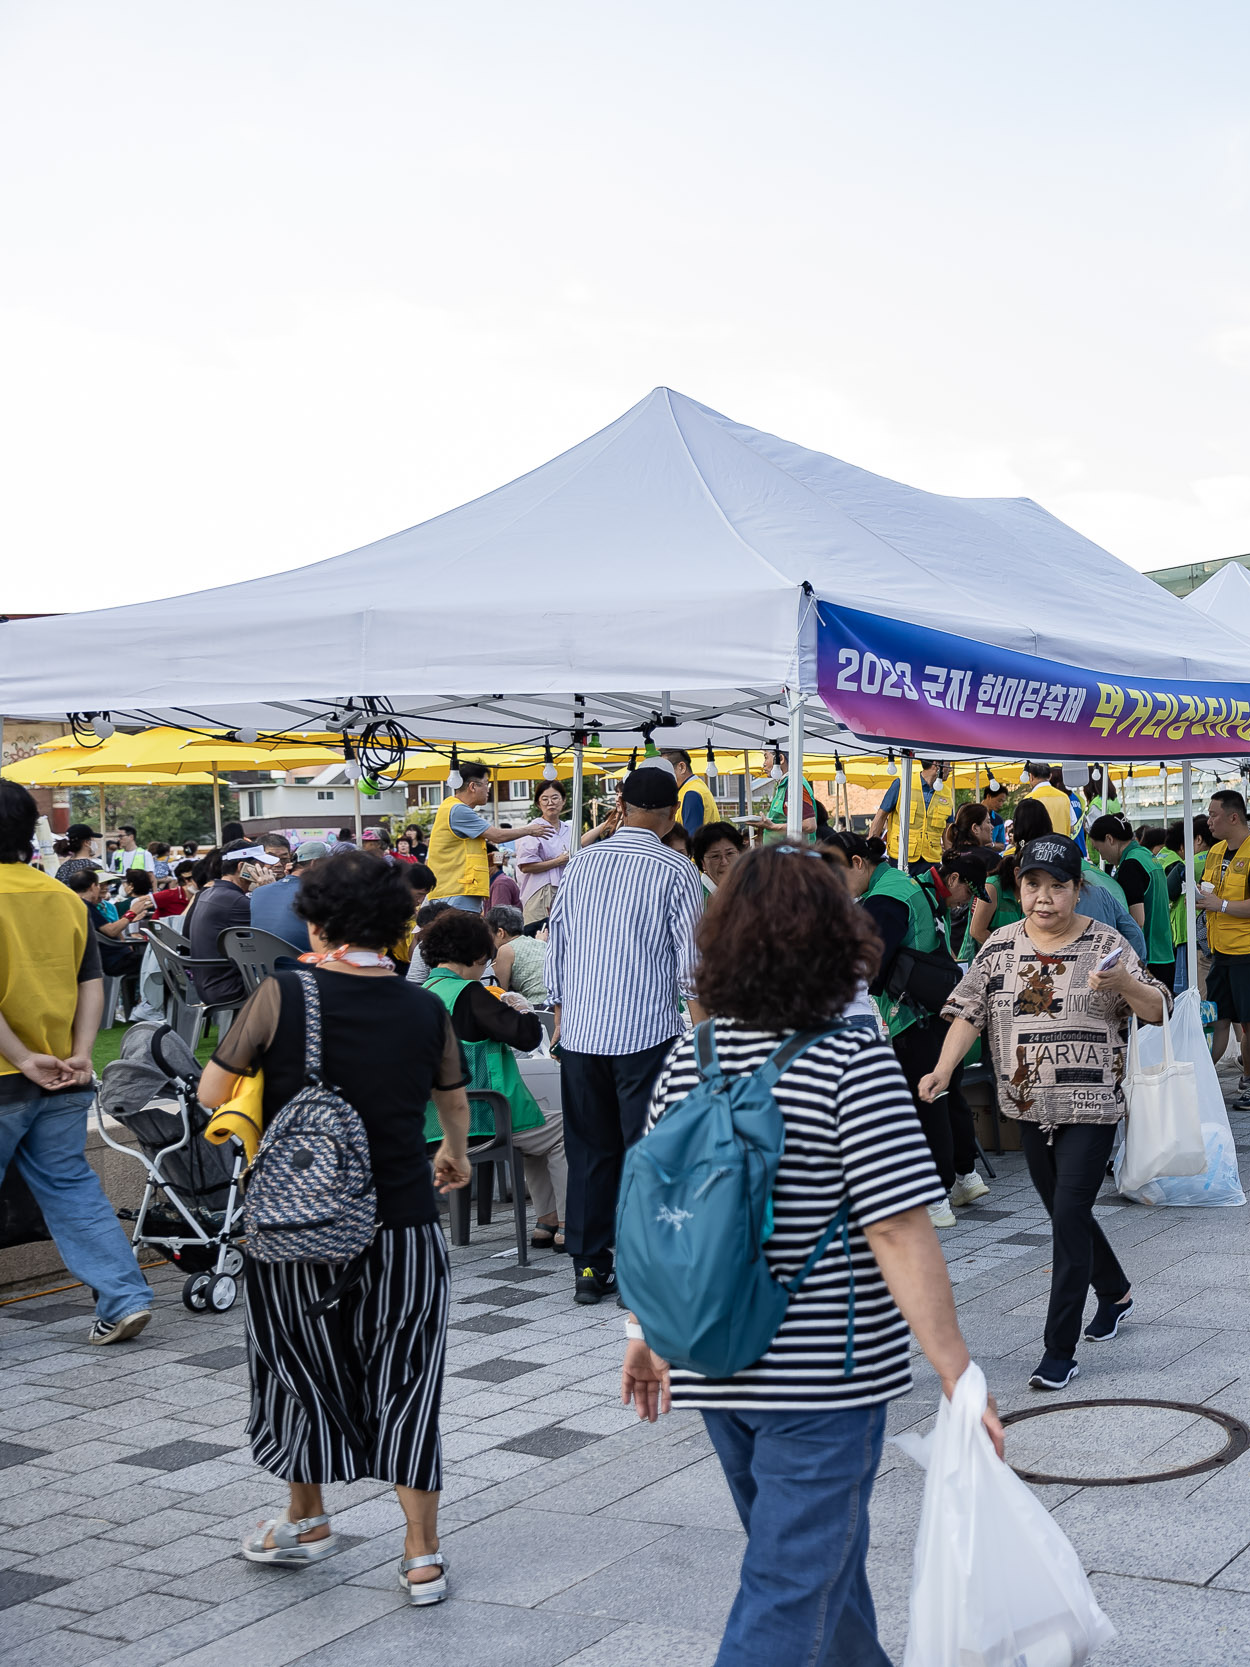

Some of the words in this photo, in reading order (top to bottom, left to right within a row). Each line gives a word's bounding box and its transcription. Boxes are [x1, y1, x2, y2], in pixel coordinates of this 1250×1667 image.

[836, 648, 919, 701] 2023
[922, 665, 972, 712] 군자
[976, 673, 1086, 723] 한마당축제
[1005, 953, 1014, 974] plac
[1029, 1034, 1039, 1042] 24
[1023, 1043, 1099, 1066] L'ARVA
[1100, 1047, 1110, 1069] plac
[1072, 1090, 1114, 1101] fabrex
